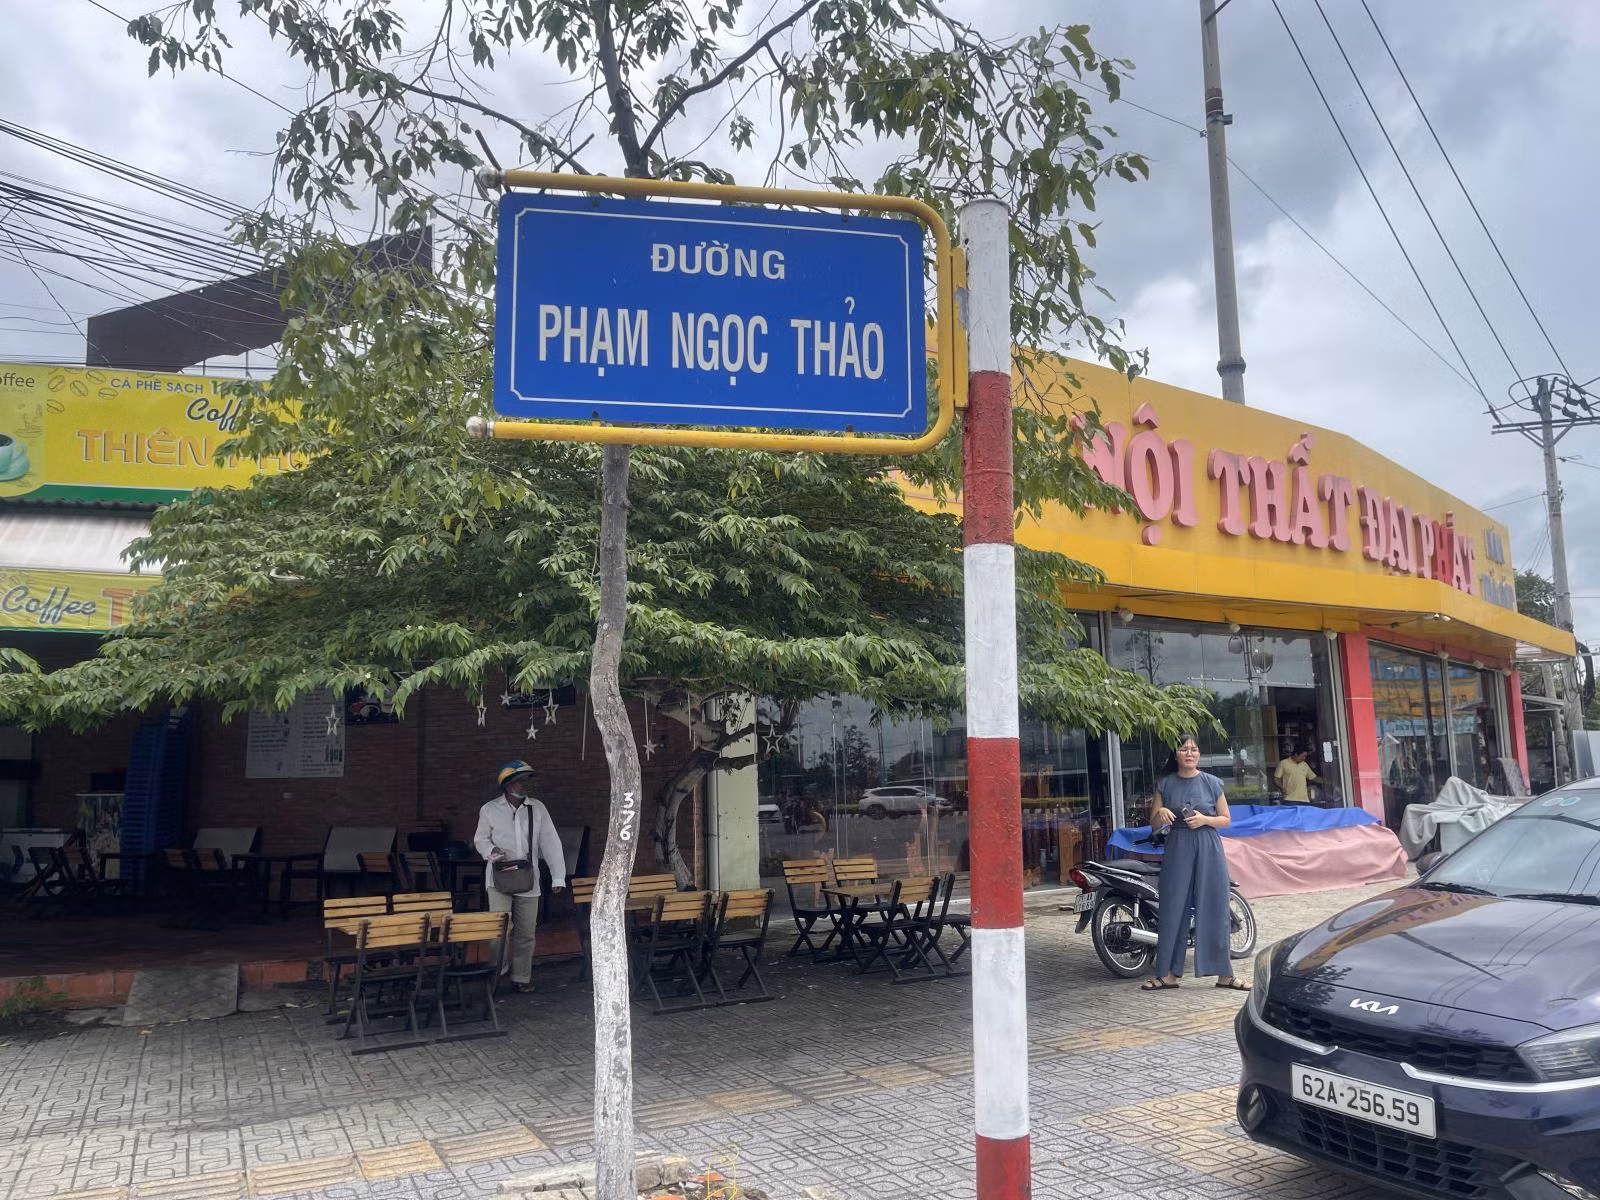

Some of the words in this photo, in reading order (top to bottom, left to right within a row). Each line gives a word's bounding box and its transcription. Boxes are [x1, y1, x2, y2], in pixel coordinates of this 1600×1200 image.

[651, 240, 785, 280] ĐƯỜNG
[539, 304, 648, 377] PHẠM
[672, 311, 768, 386] NGỌC
[790, 296, 884, 380] THẢO
[77, 427, 211, 467] THIÊN
[1207, 432, 1352, 552] THẤT
[1357, 484, 1417, 576] ĐẠI
[1412, 511, 1477, 596] PHÁT
[2, 585, 96, 625] Coffee
[620, 792, 635, 841] 376
[1302, 1074, 1420, 1126] 62A-256.59
